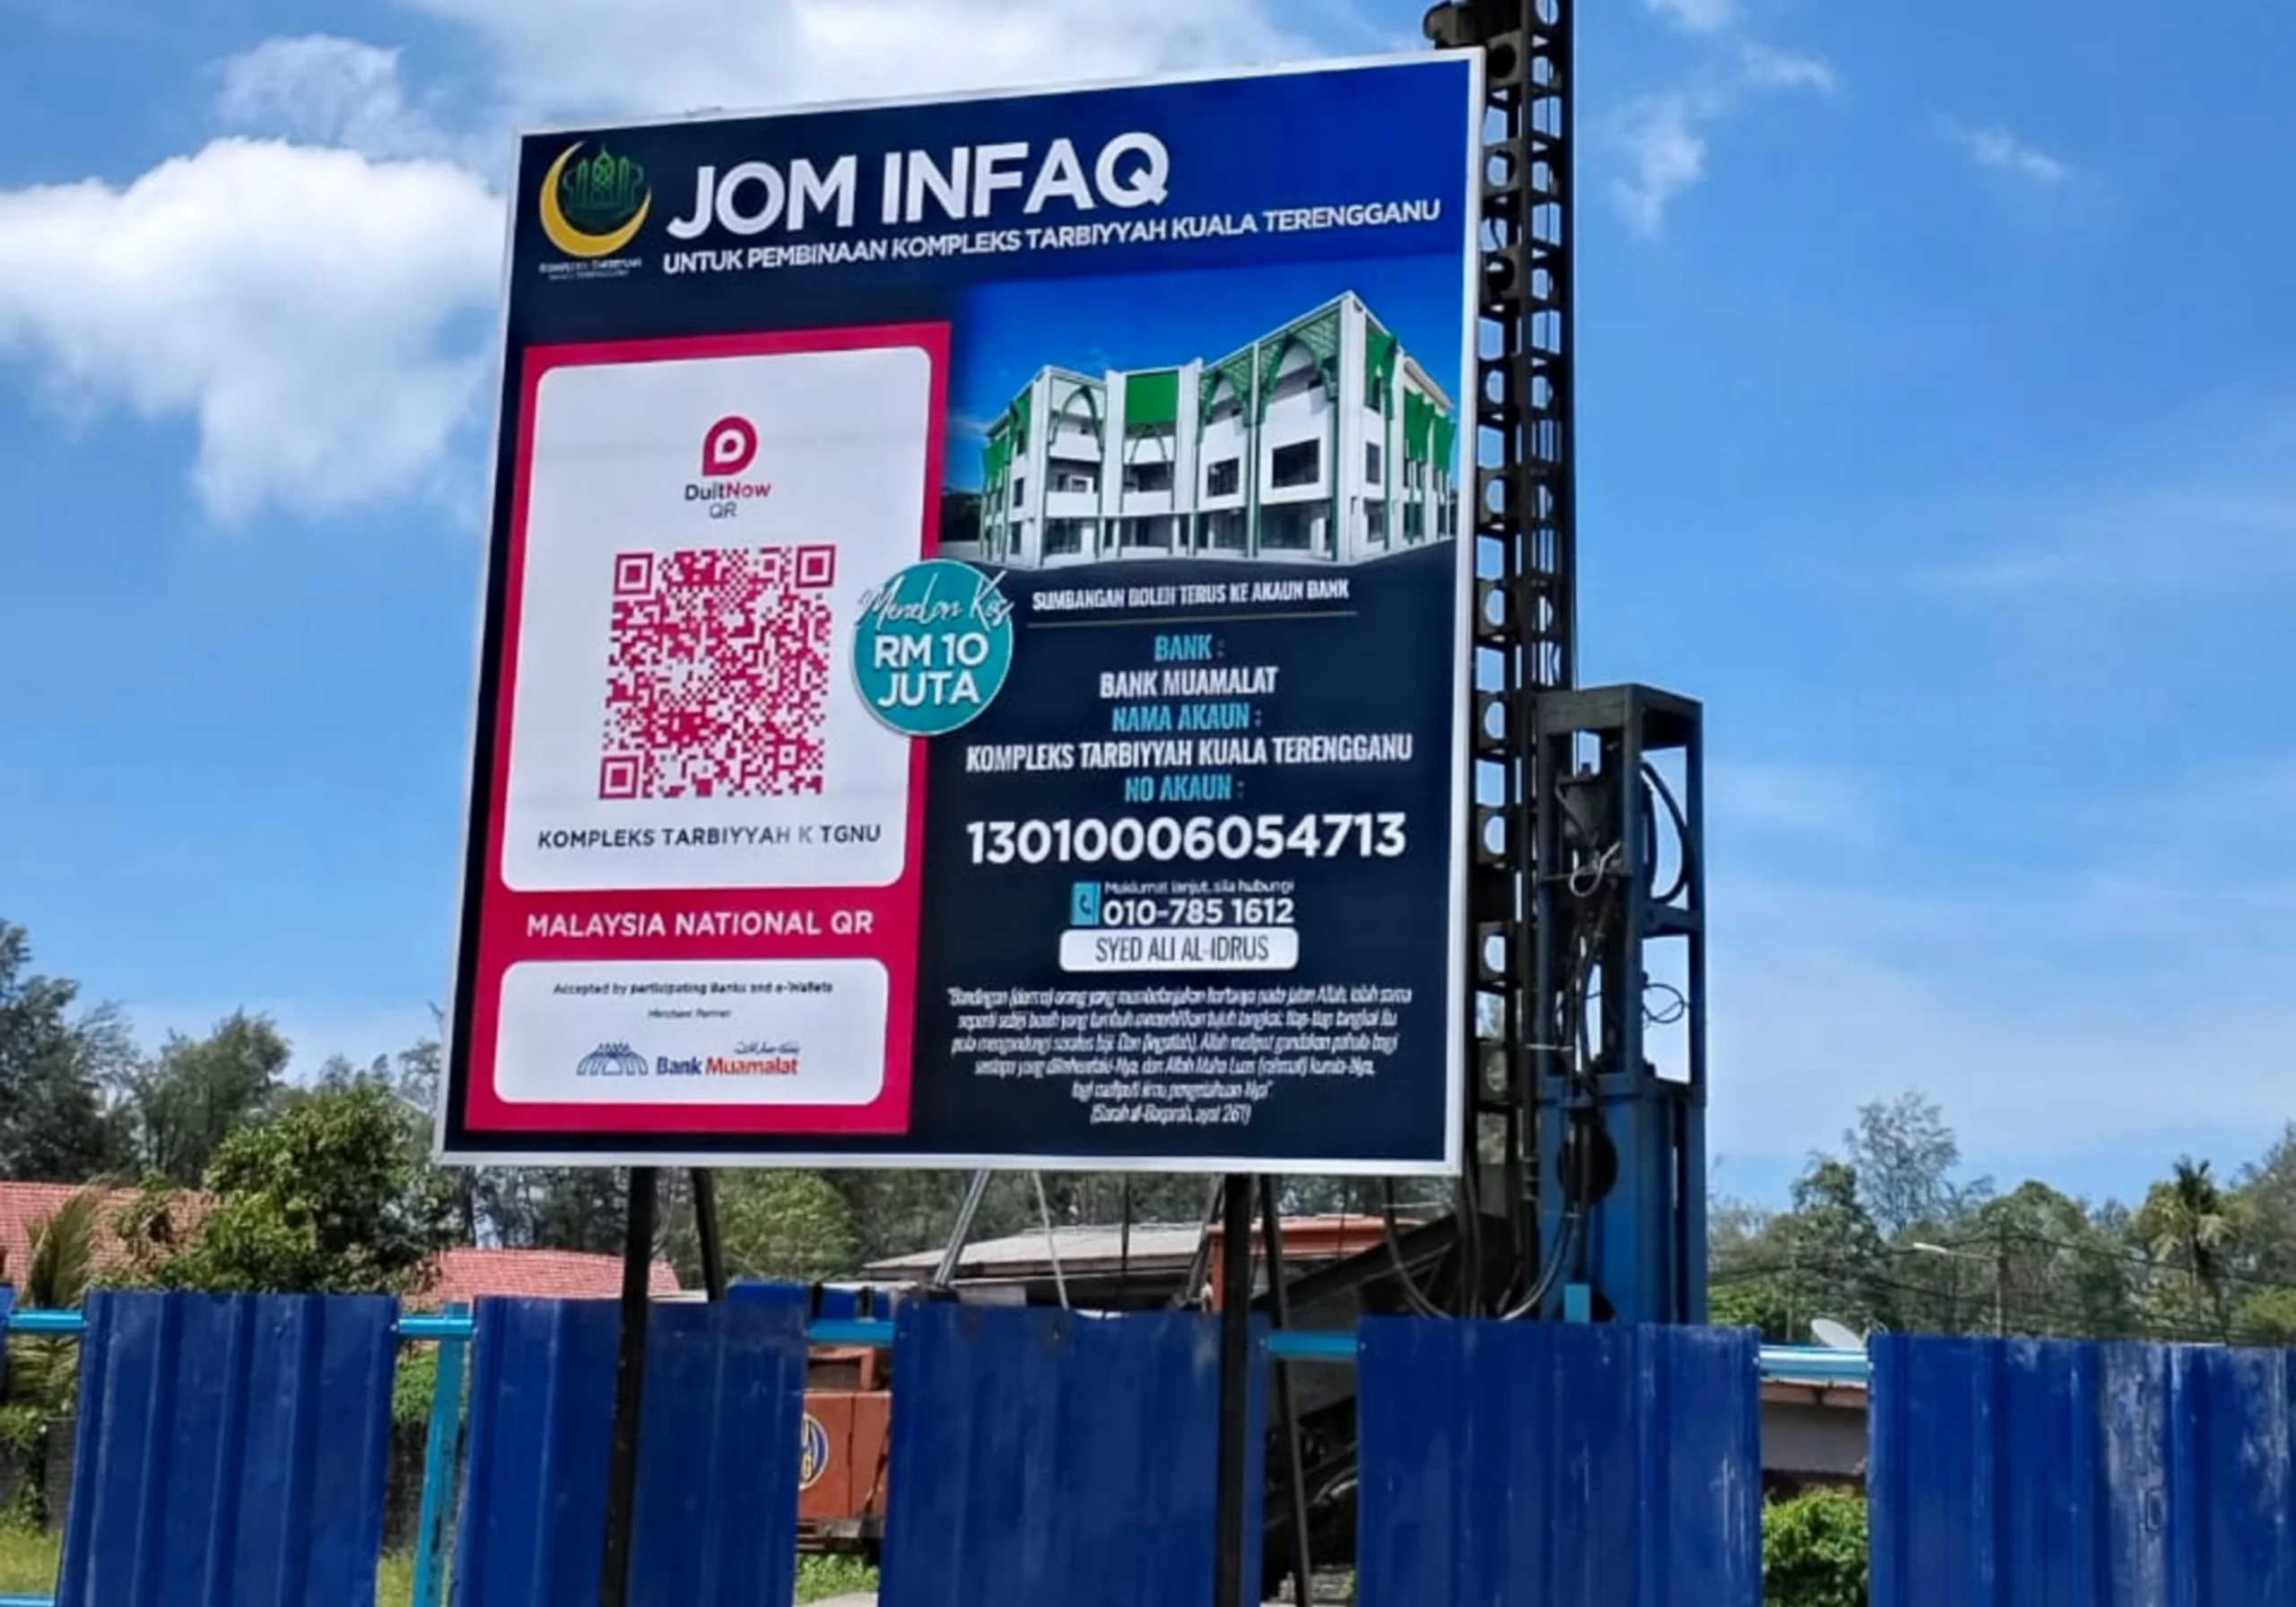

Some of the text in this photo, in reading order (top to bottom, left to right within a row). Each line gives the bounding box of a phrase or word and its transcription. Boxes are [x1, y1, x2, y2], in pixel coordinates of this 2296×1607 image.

[666, 131, 1170, 239] JOM INFAQ
[664, 246, 744, 274] UNTUK
[747, 238, 891, 269] PEMBINAAN
[892, 230, 1022, 259] KOMPLEKS
[1025, 219, 1167, 250] TARBIYYAH
[1171, 213, 1257, 240] KUALA
[1263, 199, 1442, 232] TERENGGANU
[684, 482, 771, 500] DuitNow
[709, 500, 737, 519] QR
[1032, 579, 1350, 611] SUMBANGAN BOLEH TERUS KE AKAUN BANK
[874, 631, 989, 670] RM 10
[1153, 634, 1213, 663] BANK
[877, 670, 981, 708] JUTA
[1100, 666, 1279, 699] BANK MUAMALAT
[1112, 706, 1172, 732] NAMA
[1177, 703, 1250, 730] AKAUN
[966, 734, 1413, 772] KOMPLEKS TARBIYYAH KUALA TERENGGANU
[1125, 776, 1153, 804] NO
[1159, 774, 1231, 802] AKAUN
[538, 824, 882, 848] KOMPLEKS TARBIYYAH K TGNU
[966, 812, 1407, 865] 13010006054713
[1238, 879, 1294, 894] hubungi
[526, 909, 874, 938] MALAYSIA NATIONAL QR
[1103, 898, 1295, 926] 010-785 1612
[1095, 935, 1269, 963] SYED ALI AL-IDRUS
[552, 983, 609, 997] Accepted
[613, 983, 627, 996] by
[630, 982, 708, 995] participating
[657, 1055, 798, 1075] Bank Muamalat
